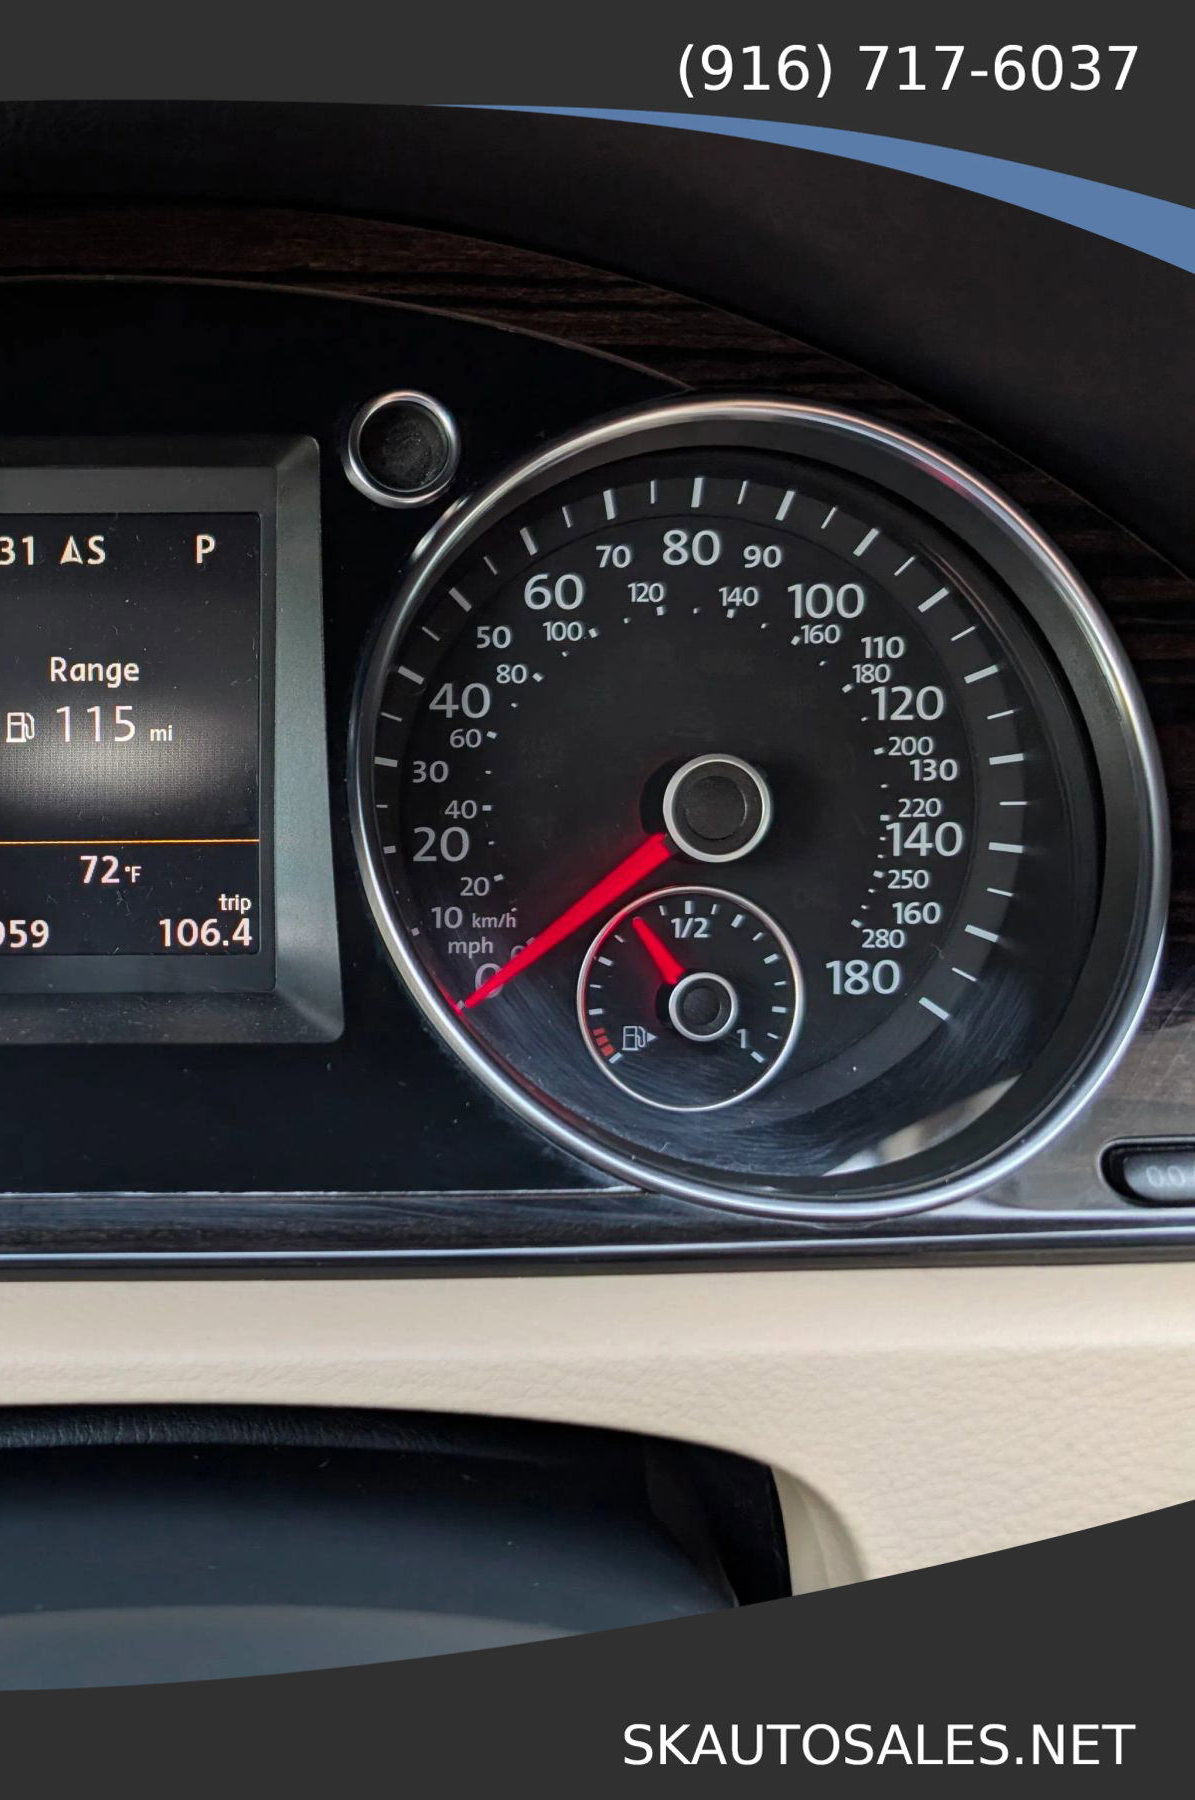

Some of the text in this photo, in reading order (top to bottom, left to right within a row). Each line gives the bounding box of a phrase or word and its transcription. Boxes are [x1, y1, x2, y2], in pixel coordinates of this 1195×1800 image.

[196, 534, 216, 564] P
[595, 545, 632, 569] 70
[662, 529, 721, 566] 80
[743, 545, 782, 569] 90
[524, 573, 584, 610] 60
[627, 582, 665, 603] 120
[718, 586, 759, 607] 140
[787, 583, 865, 619] 100
[476, 625, 512, 649] 50
[542, 621, 583, 642] 100
[800, 624, 841, 644] 160
[860, 636, 905, 659] 110
[50, 656, 140, 689] Range
[496, 663, 528, 684] 80
[852, 663, 891, 684] 180
[429, 682, 491, 719] 40
[870, 685, 945, 721] 120
[56, 705, 173, 743] 115 mi
[449, 728, 482, 749] 60
[888, 736, 934, 756] 200
[412, 760, 449, 784] 30
[909, 758, 958, 782] 130
[444, 799, 478, 820] 40
[898, 797, 942, 818] 220
[413, 826, 470, 862] 20
[884, 820, 963, 857] 140
[80, 855, 120, 884] 72
[887, 869, 930, 890] 250
[460, 876, 490, 897] 20
[218, 893, 252, 915] trip
[892, 901, 941, 925] 160
[431, 906, 463, 929] 10
[472, 912, 517, 929] km/h
[670, 917, 709, 939] 1/2
[159, 917, 253, 947] 106.4
[861, 928, 906, 949] 280
[448, 936, 494, 960] mph
[825, 959, 901, 995] 180
[736, 1028, 747, 1049] 1
